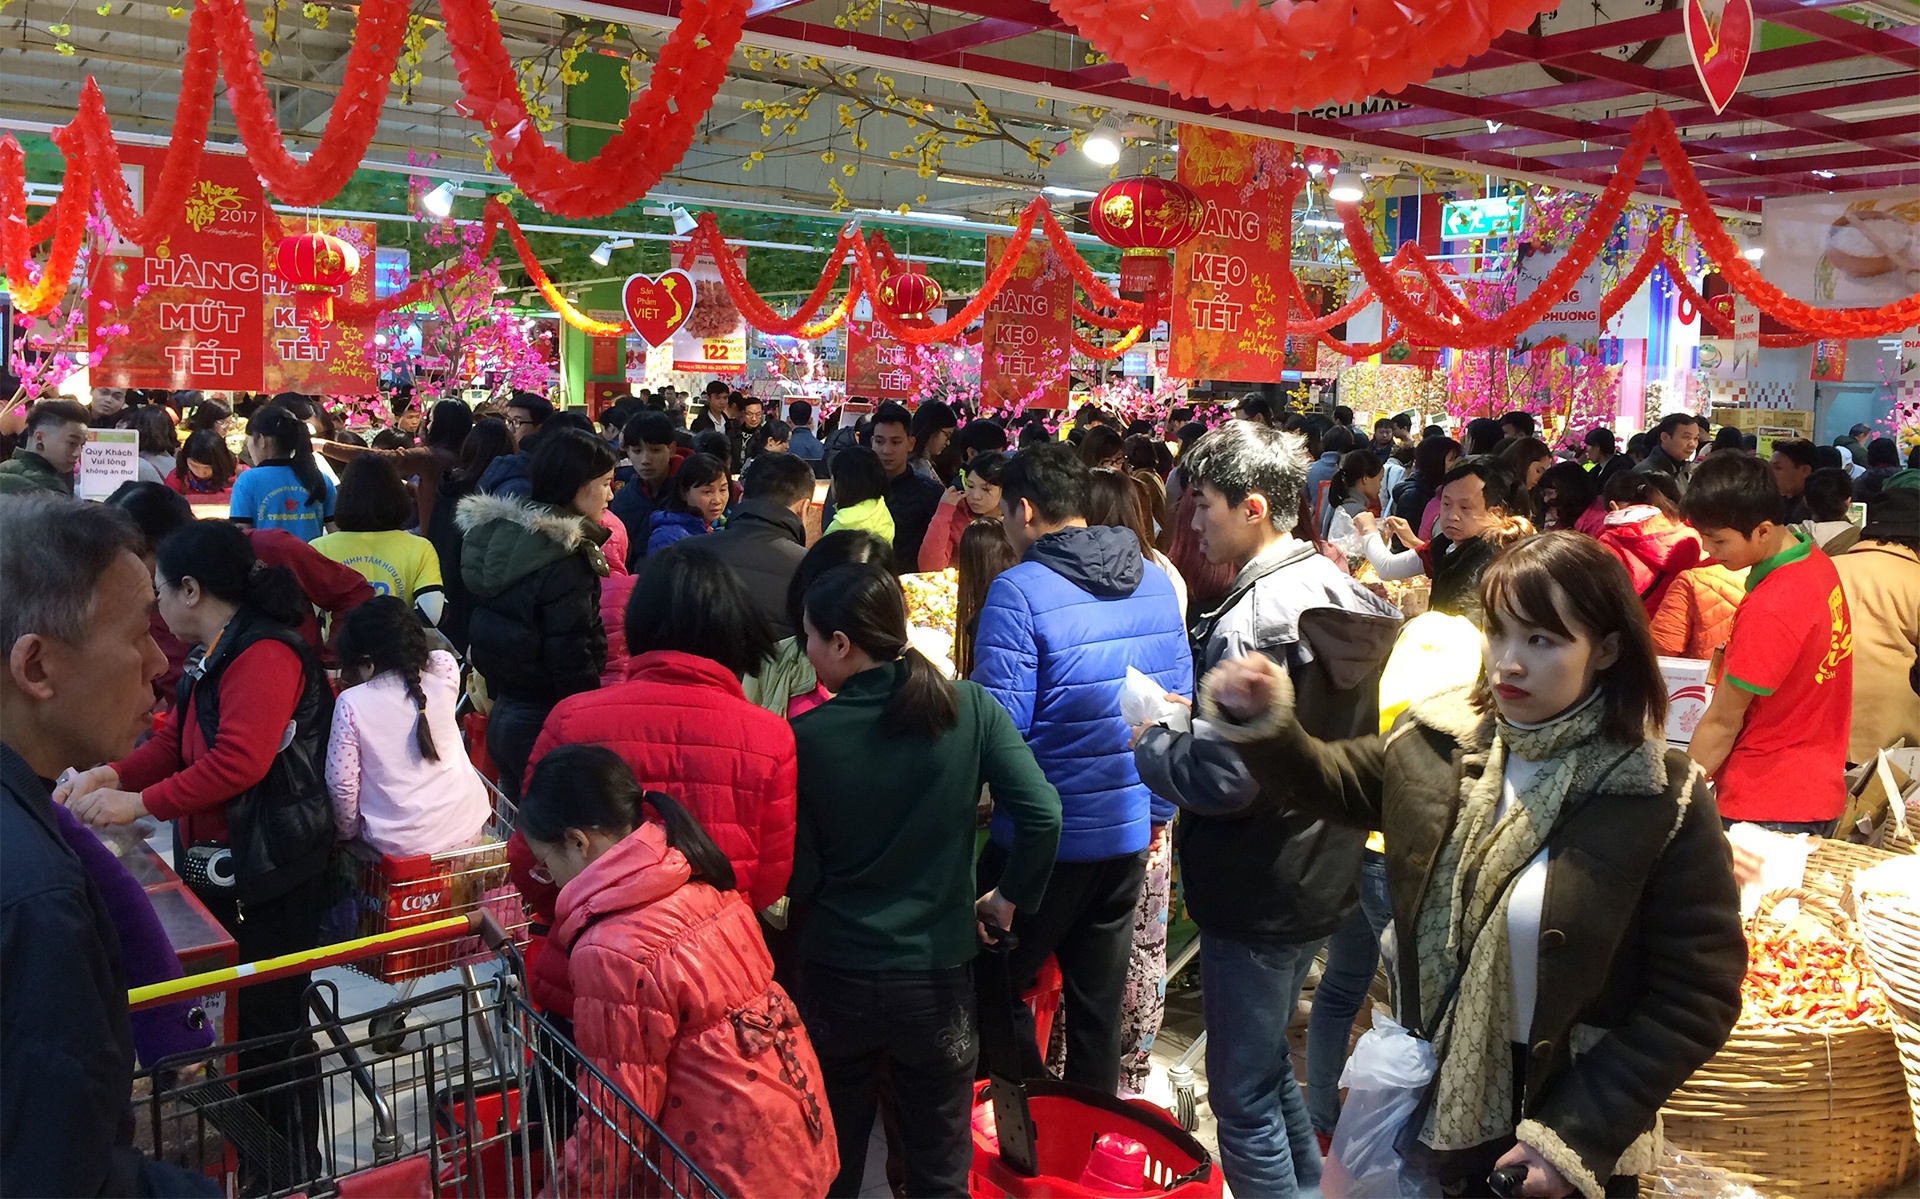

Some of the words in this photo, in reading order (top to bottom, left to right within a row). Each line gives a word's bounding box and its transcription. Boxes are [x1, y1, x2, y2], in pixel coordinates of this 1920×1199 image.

[220, 209, 257, 224] 2017
[1199, 200, 1260, 241] ÀNG
[145, 254, 259, 292] HÀNG
[1192, 252, 1247, 290] KẸO
[160, 298, 245, 333] MỨT
[633, 307, 660, 321] VIỆT
[989, 288, 1048, 316] HÀNG
[1192, 292, 1242, 332] TẾT
[1542, 309, 1597, 323] PHƯƠNG
[277, 332, 331, 361] TẾT
[995, 323, 1039, 349] KẸO
[164, 339, 241, 376] TẾT
[702, 344, 729, 360] 122
[998, 349, 1036, 378] TẾT
[91, 457, 105, 465] Vui
[105, 448, 133, 457] Khách
[342, 555, 363, 567] NHH
[364, 555, 383, 567] TÂM
[401, 889, 442, 912] COSY
